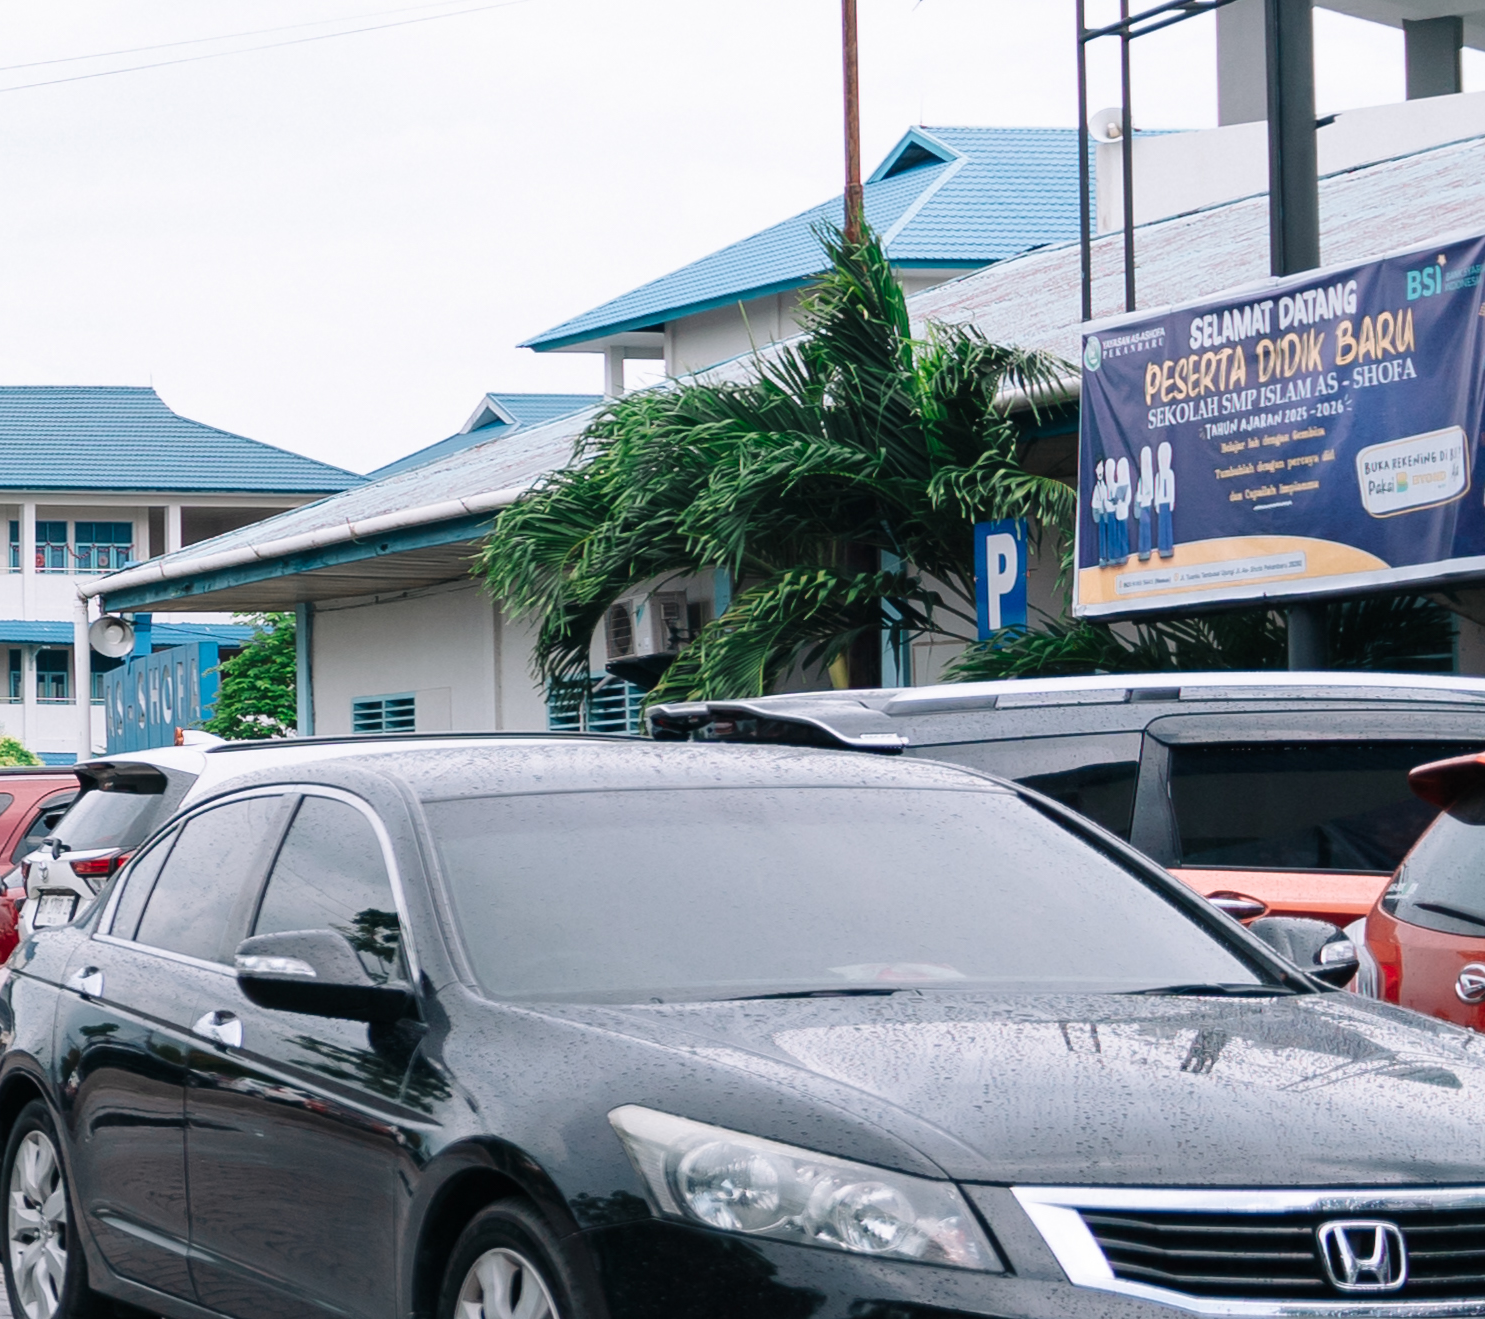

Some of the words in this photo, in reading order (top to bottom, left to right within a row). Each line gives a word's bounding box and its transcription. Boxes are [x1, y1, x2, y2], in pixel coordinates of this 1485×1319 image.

[1407, 263, 1442, 301] BSI
[1189, 300, 1274, 350] SELAMAT
[1278, 280, 1358, 331] DATANG
[1102, 338, 1164, 359] PEKANBARU
[1144, 345, 1247, 407] PESERTA
[1256, 327, 1325, 383] DIDIK
[1335, 307, 1415, 366] BARU
[1148, 401, 1219, 429] SEKOLAH
[1222, 389, 1257, 415] SMP
[1259, 377, 1312, 408] ISLAM
[1314, 372, 1339, 397] AS
[1352, 357, 1417, 389] SHOFA
[1204, 418, 1239, 440] TAHUN
[1240, 410, 1283, 432] AJARAN
[1284, 406, 1308, 423] 2025
[1364, 461, 1390, 475] BUKA
[1368, 477, 1395, 496] Pakai
[986, 533, 1018, 631] P
